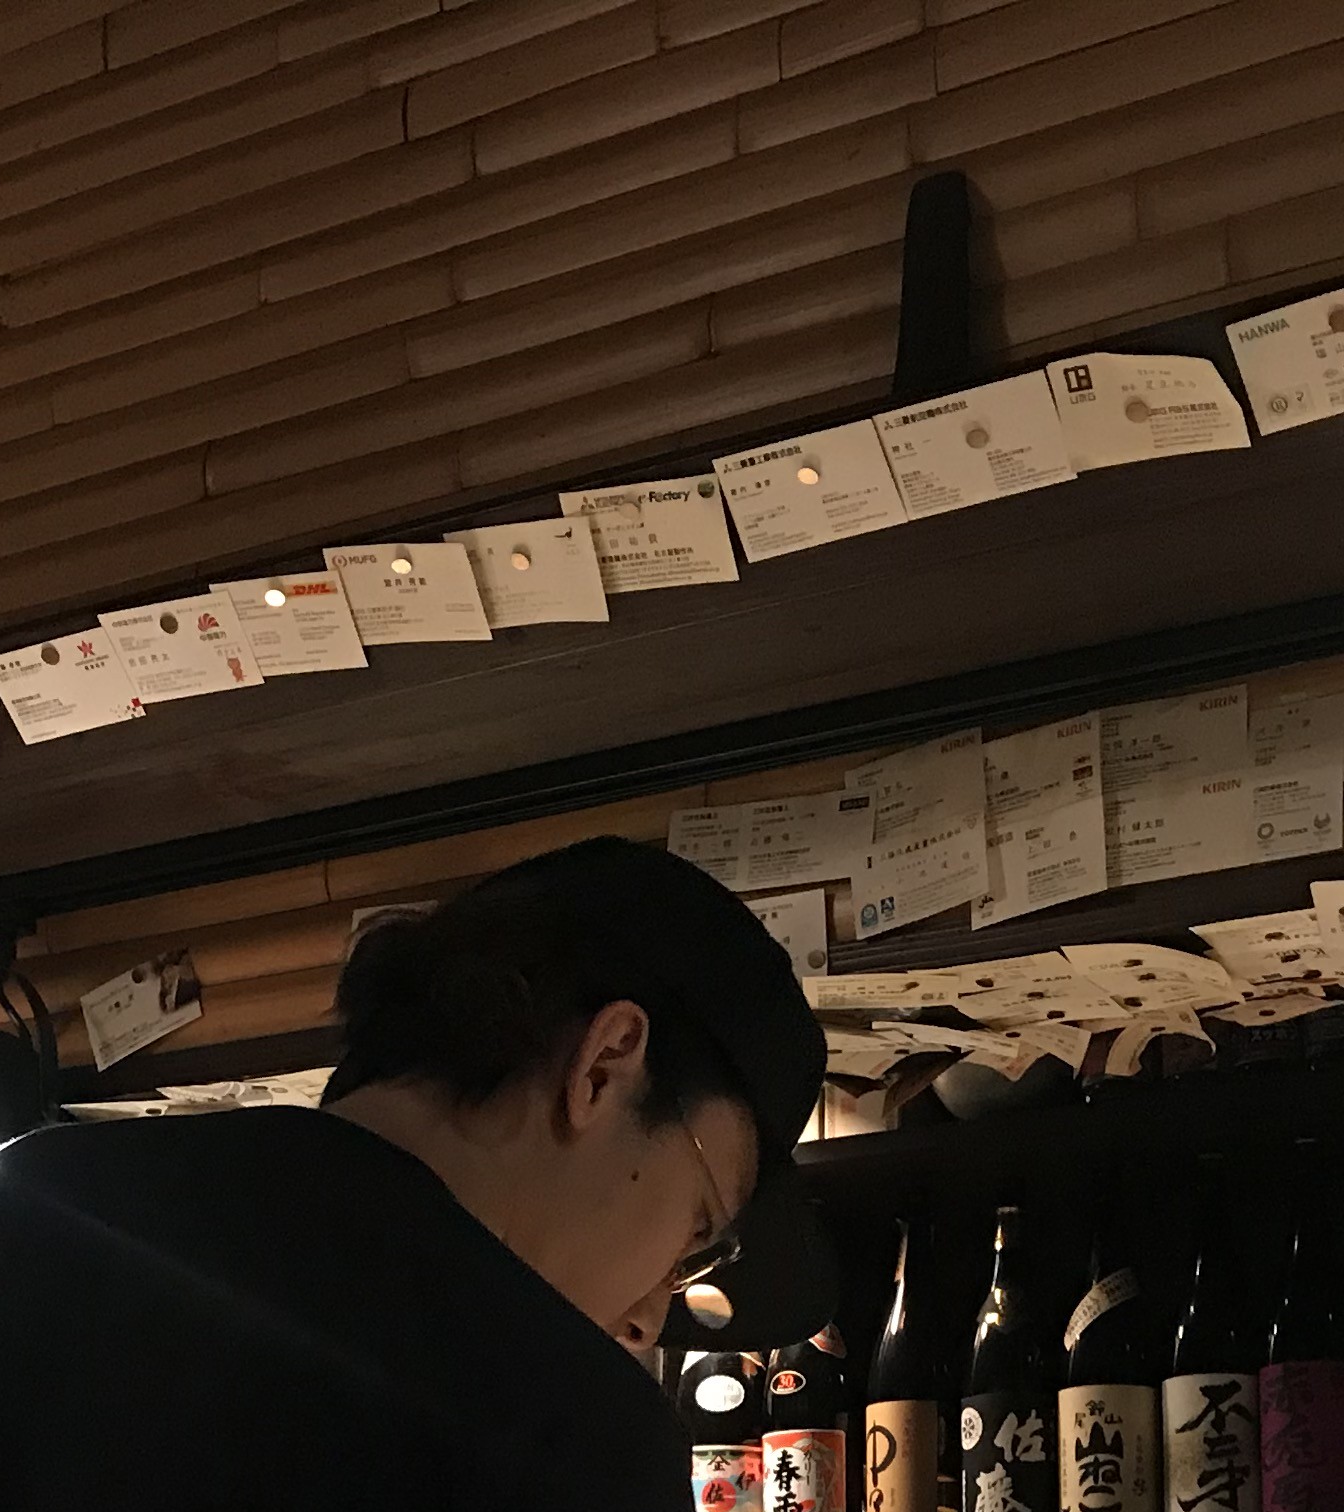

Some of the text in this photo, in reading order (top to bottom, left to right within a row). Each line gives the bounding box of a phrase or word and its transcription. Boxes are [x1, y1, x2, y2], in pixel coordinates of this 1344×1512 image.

[1238, 317, 1291, 343] HANWA
[293, 583, 331, 596] DHL
[1199, 696, 1238, 712] KIRIN
[1057, 721, 1092, 739] KIRIN
[940, 735, 975, 754] KIRIN
[1201, 778, 1242, 794] KIRIN
